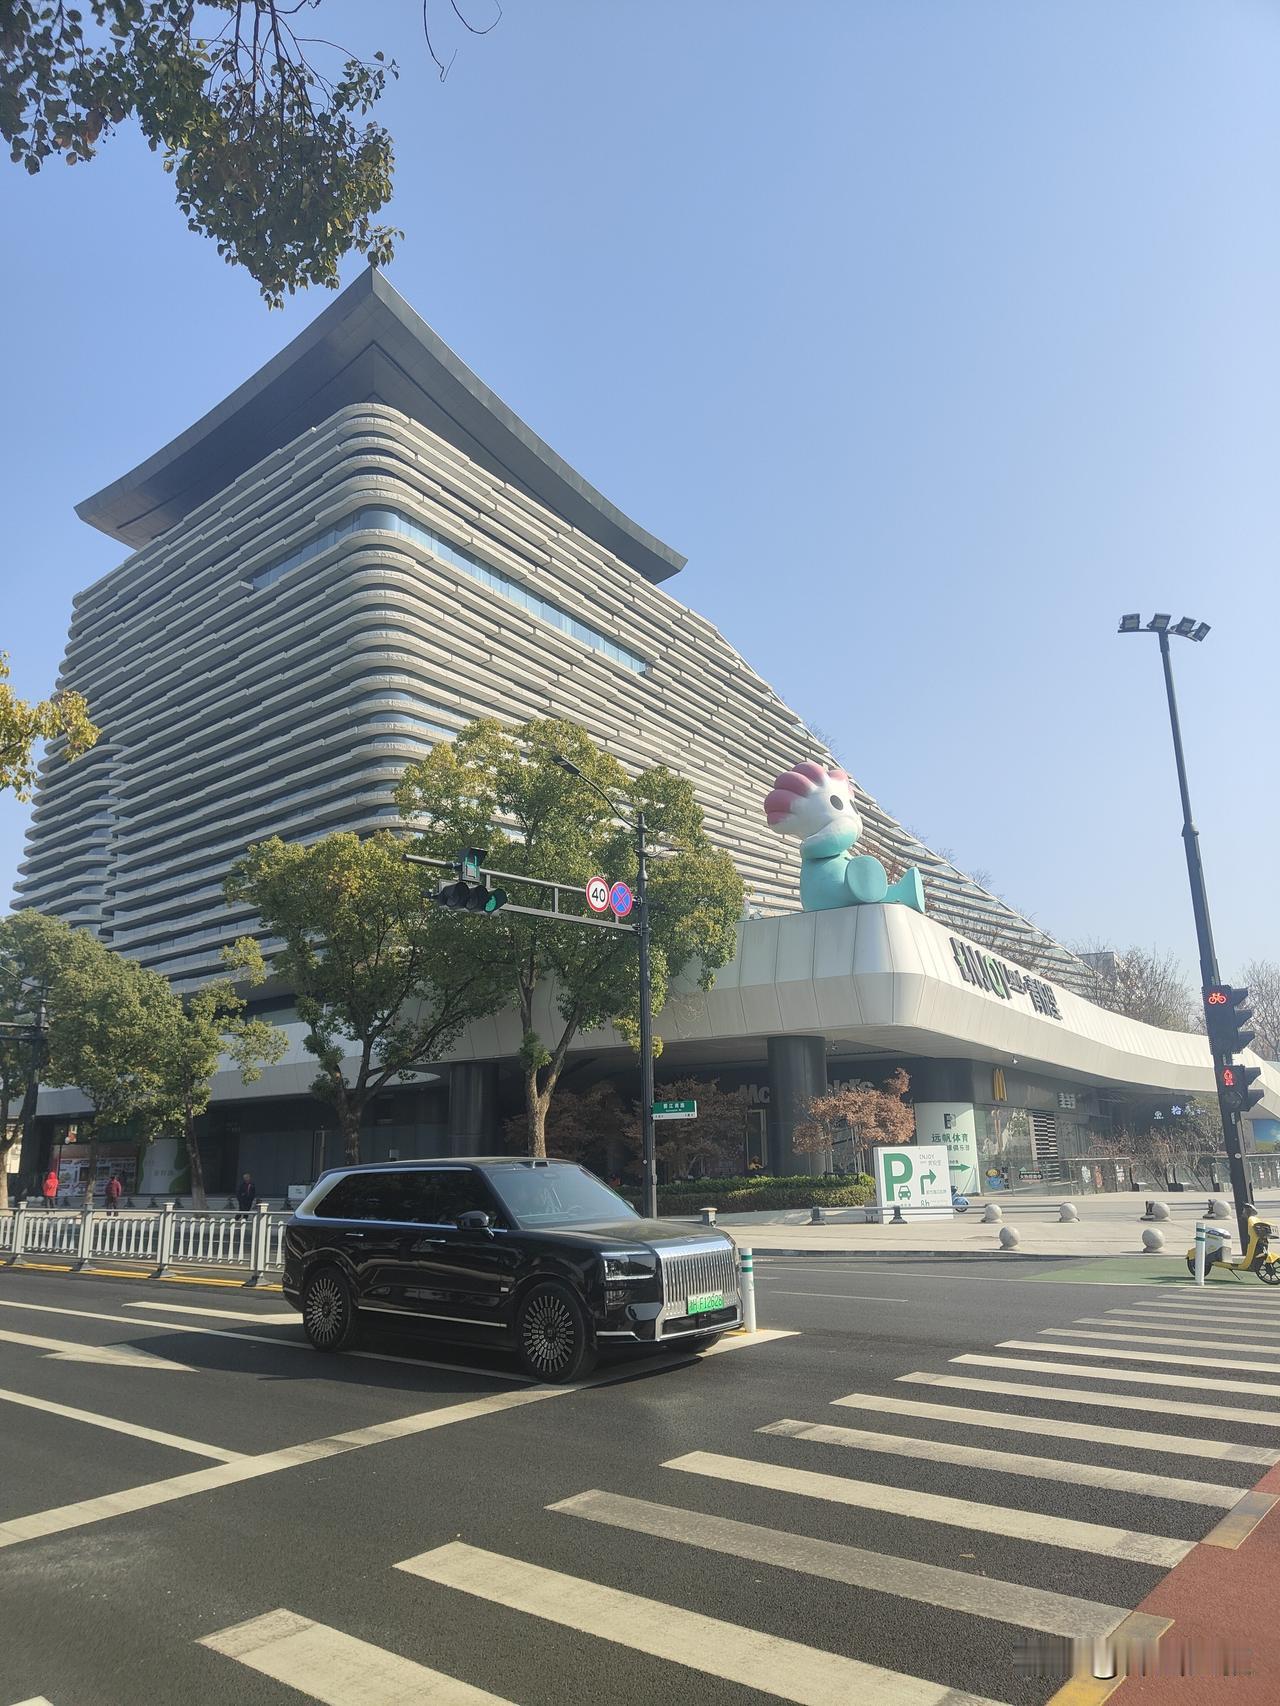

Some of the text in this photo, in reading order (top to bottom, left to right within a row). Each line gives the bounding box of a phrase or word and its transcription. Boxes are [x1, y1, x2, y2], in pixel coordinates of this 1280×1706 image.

[591, 888, 606, 903] 40
[949, 936, 1012, 1000] ENJOY
[931, 1132, 968, 1143] 远帆体育
[883, 1153, 913, 1201] P
